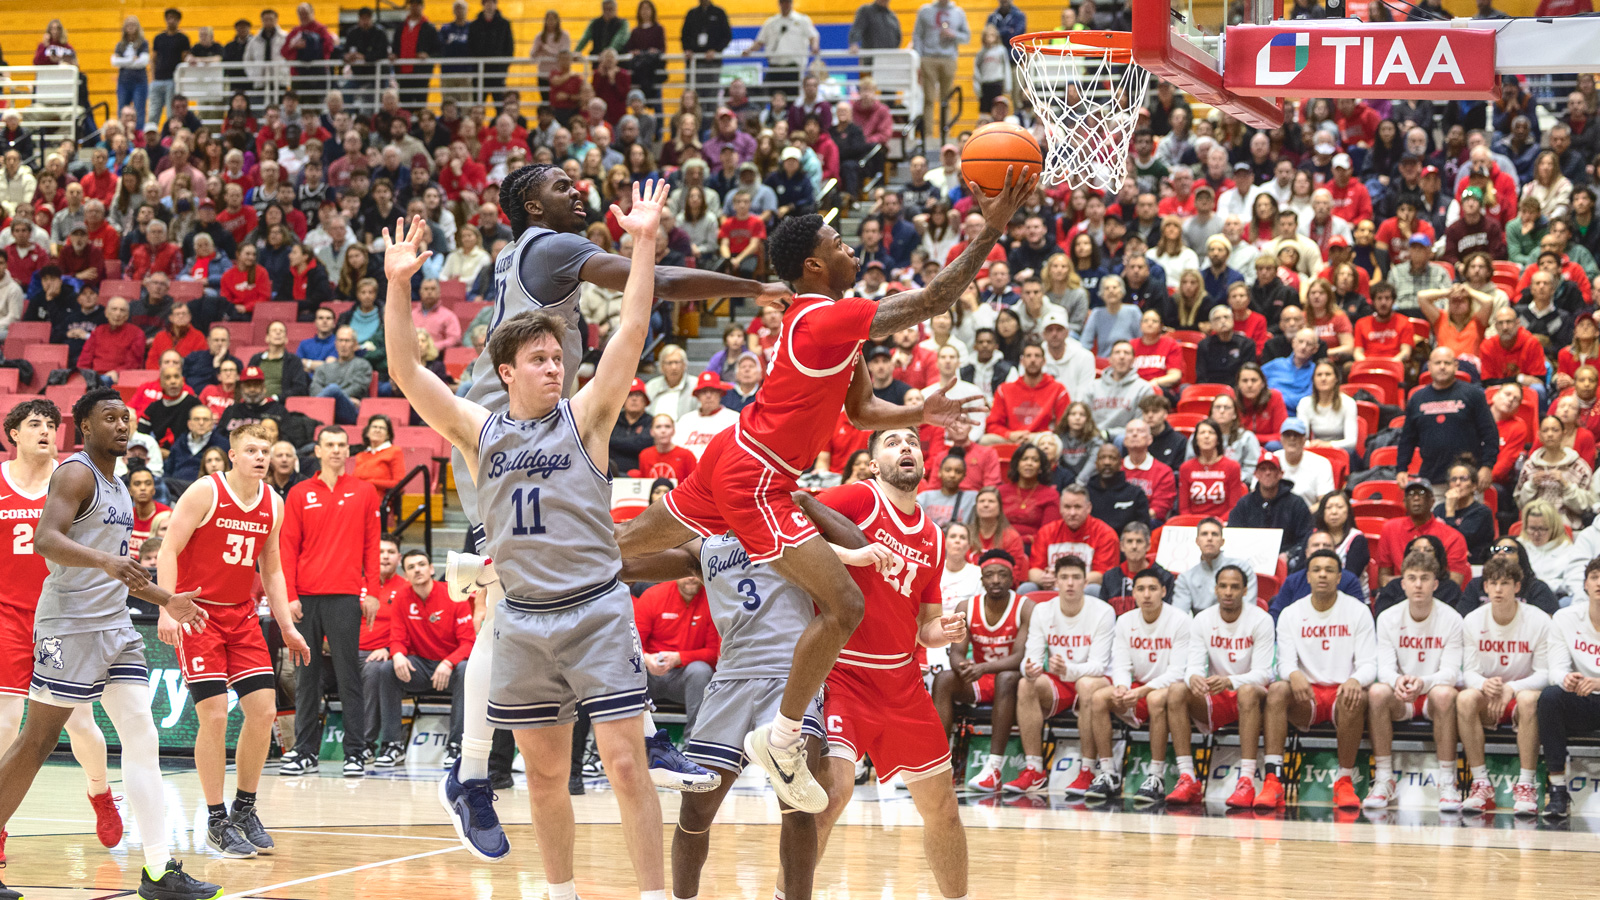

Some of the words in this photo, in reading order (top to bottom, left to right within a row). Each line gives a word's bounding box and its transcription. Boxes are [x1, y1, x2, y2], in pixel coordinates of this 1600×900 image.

[1322, 36, 1465, 85] TIAA
[488, 448, 571, 479] Bulldogs
[306, 492, 317, 503] C
[1190, 481, 1225, 504] 24
[512, 487, 546, 535] 11
[215, 518, 269, 534] CORNELL
[13, 523, 33, 555] 2
[222, 533, 256, 567] 31
[874, 528, 932, 568] CORNELL
[881, 552, 919, 598] 21
[738, 578, 761, 611] 3
[410, 603, 419, 614] C
[1301, 625, 1327, 638] LOCK
[1329, 625, 1338, 637] IT
[1339, 624, 1351, 637] IN.
[1047, 634, 1070, 648] LOCK
[1072, 635, 1081, 647] IT
[1130, 636, 1153, 650] LOCK
[1210, 635, 1233, 650] LOCK
[1235, 638, 1243, 650] IT
[1322, 640, 1330, 651] C
[1399, 635, 1423, 649] LOCK
[1425, 636, 1433, 649] IT
[1479, 639, 1505, 653] LOCK
[1507, 641, 1517, 653] IT
[1518, 641, 1533, 653] IN.
[1066, 650, 1074, 660] C
[1149, 652, 1157, 663] C
[1228, 652, 1236, 663] C
[1418, 651, 1425, 662] C
[1500, 655, 1508, 666] C
[191, 656, 206, 673] C
[828, 715, 843, 733] C
